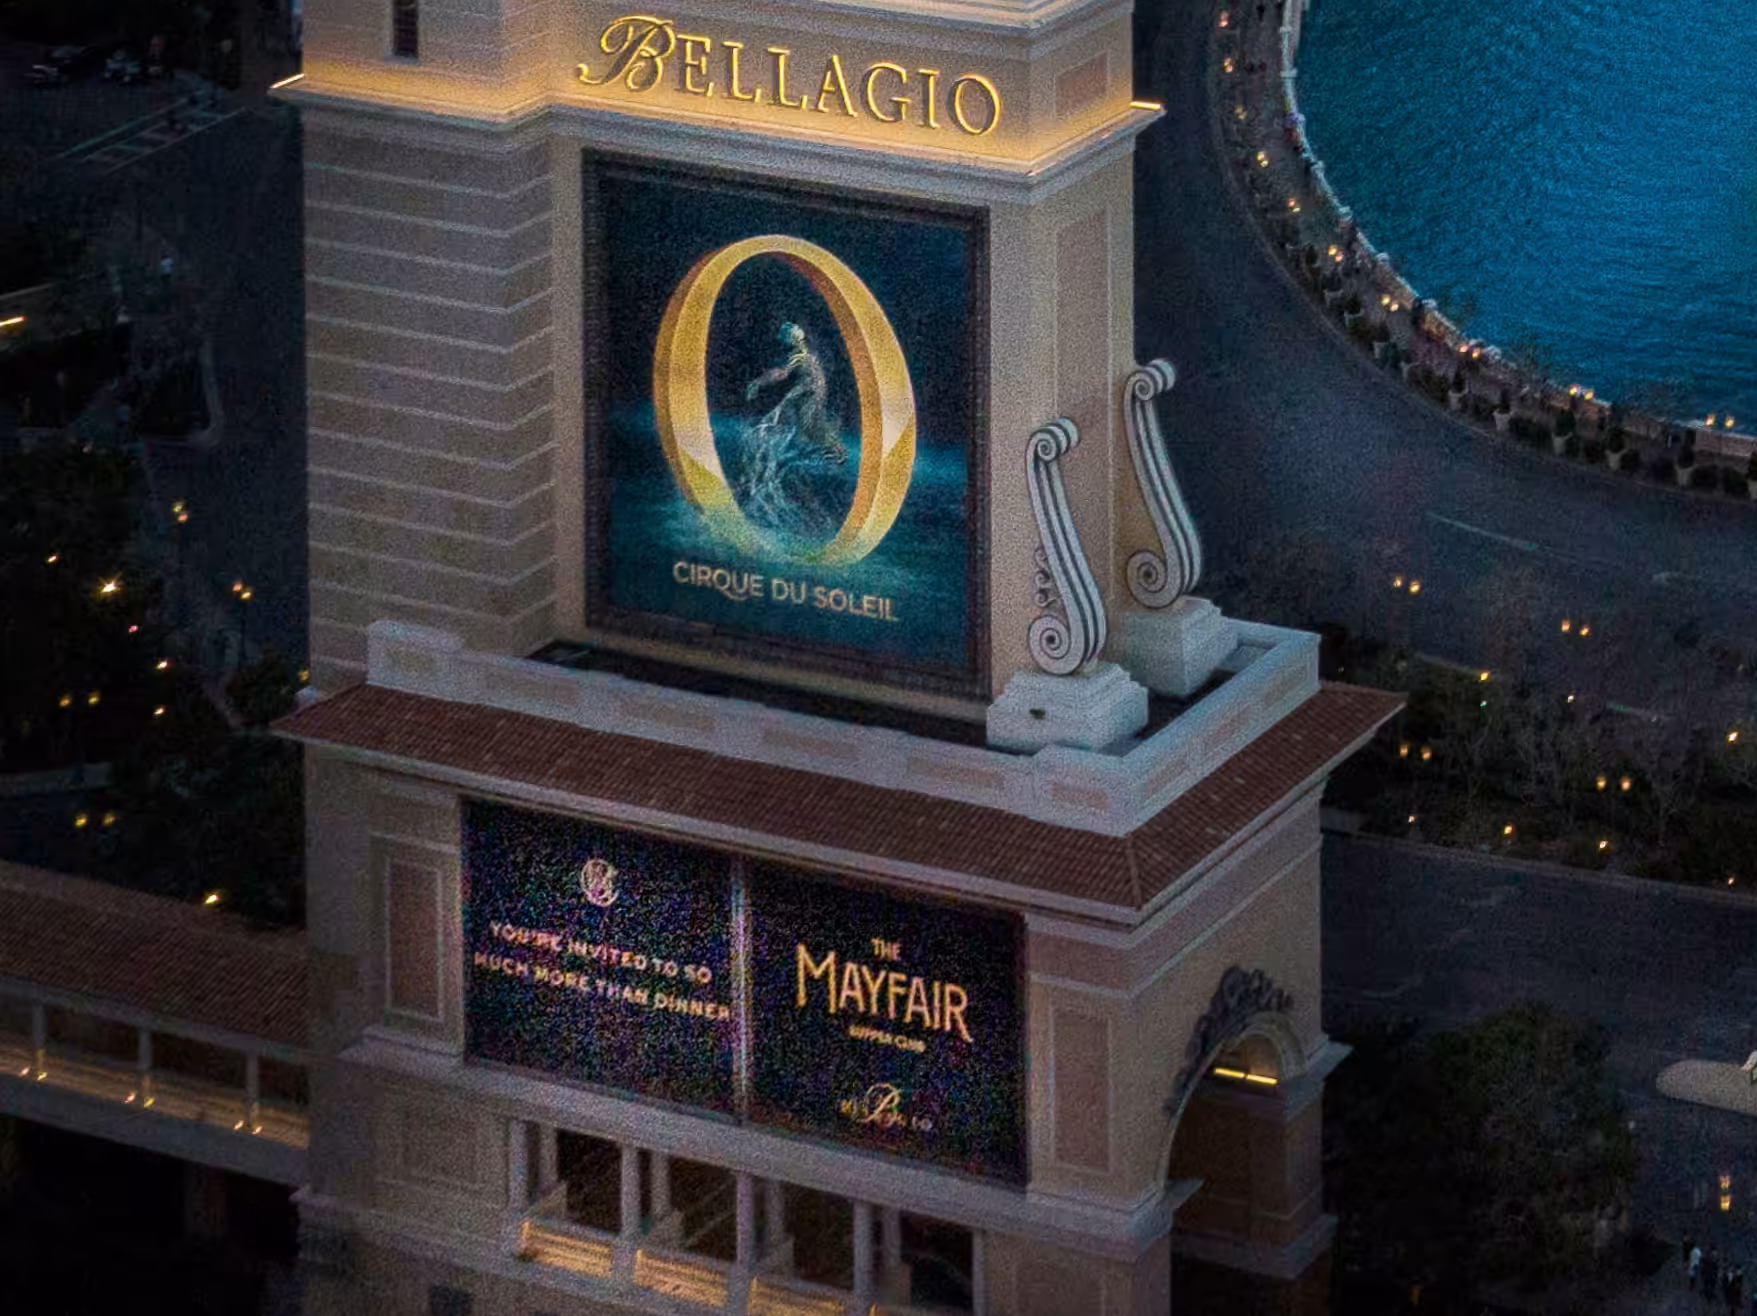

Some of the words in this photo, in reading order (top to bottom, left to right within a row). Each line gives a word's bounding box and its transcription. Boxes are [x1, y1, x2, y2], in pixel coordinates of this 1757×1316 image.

[577, 15, 1002, 136] BELLAGIO
[653, 234, 917, 565] O
[673, 561, 764, 601] CIRQUE
[771, 578, 806, 604] DU
[814, 585, 898, 621] SOLEIL
[568, 939, 647, 970] INVITED
[653, 958, 677, 977] TO
[685, 964, 712, 984] SO
[871, 938, 901, 960] THE
[474, 951, 529, 976] MUCH
[534, 966, 588, 992] MORE
[596, 979, 648, 1005] THAN
[655, 992, 730, 1019] DINNER
[797, 943, 974, 1043] MAYFAIR
